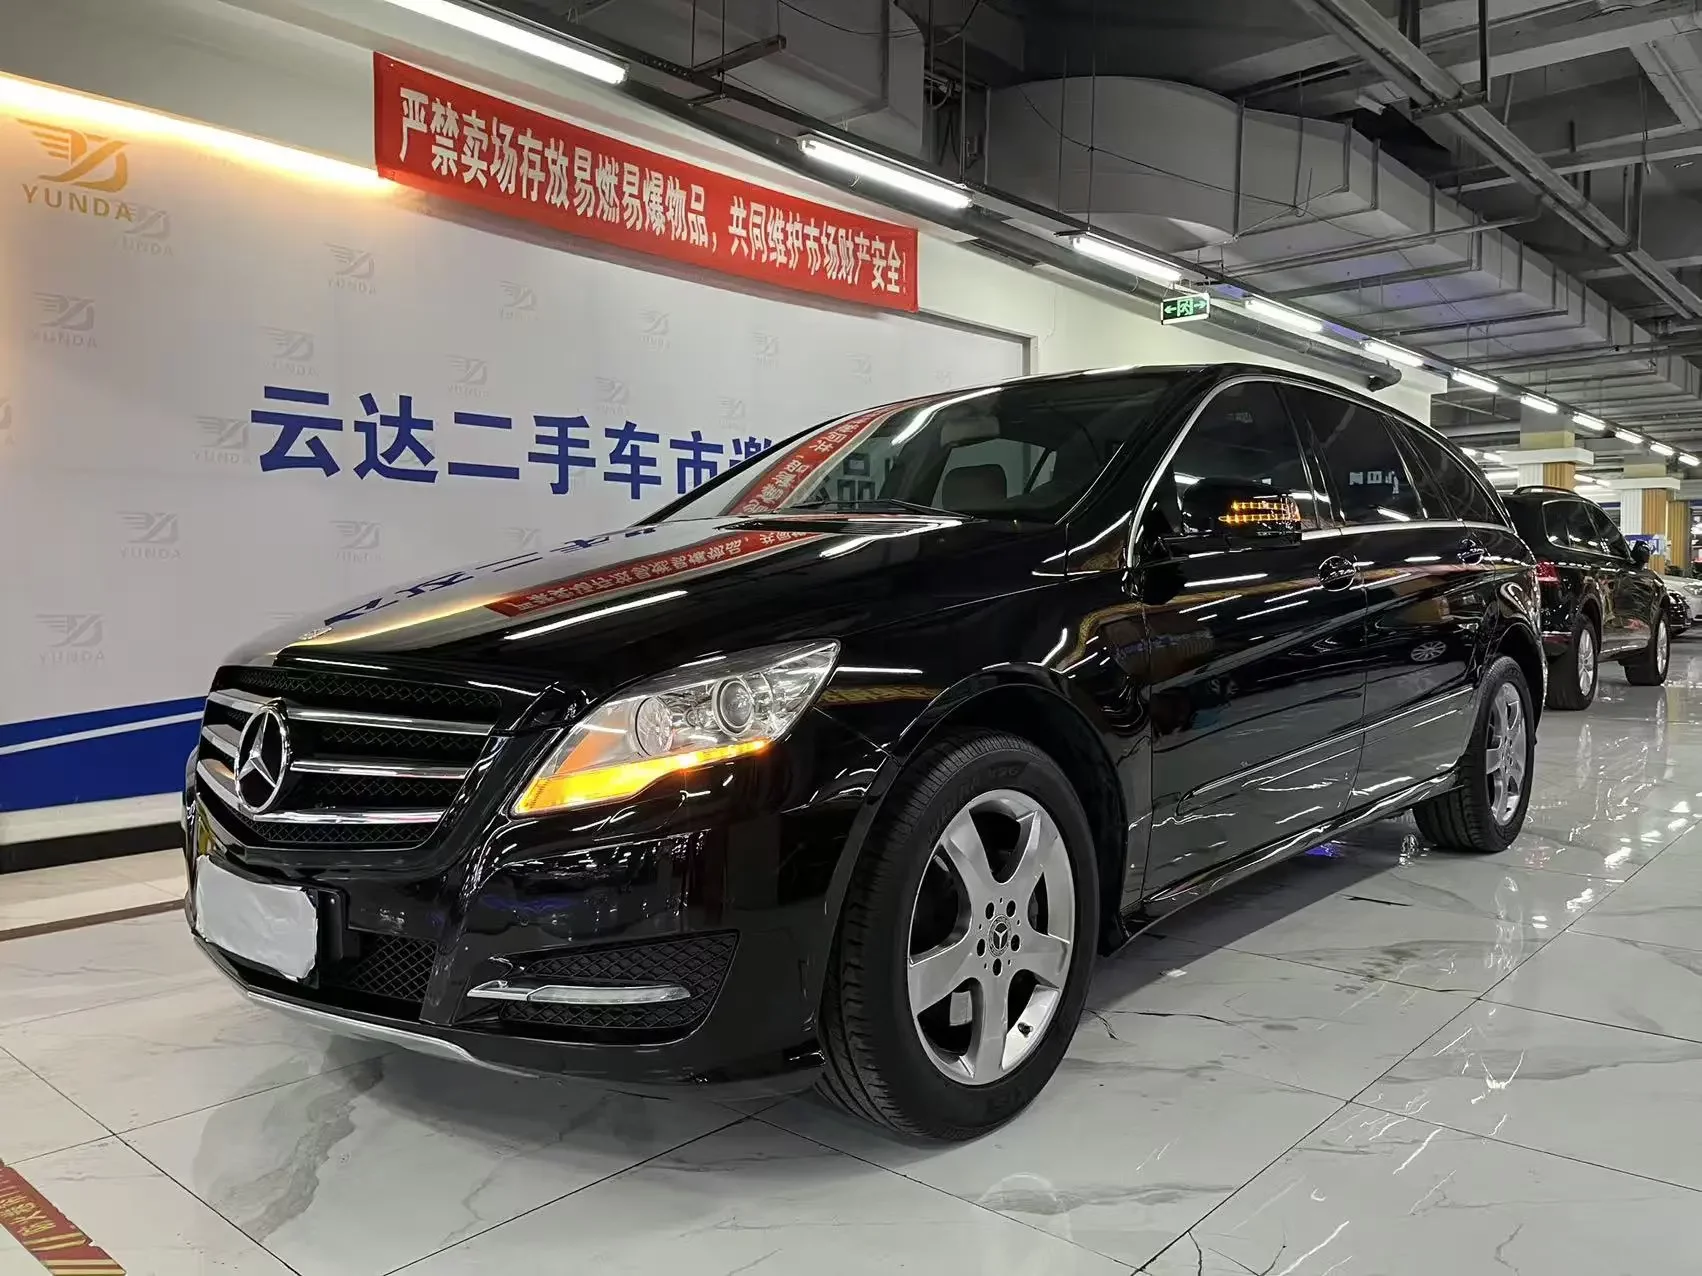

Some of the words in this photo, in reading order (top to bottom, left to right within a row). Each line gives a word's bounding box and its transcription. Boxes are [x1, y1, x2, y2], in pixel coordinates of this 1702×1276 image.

[21, 183, 133, 222] YUNDA
[119, 546, 184, 561] YUNDA
[38, 649, 105, 666] YUNDA
